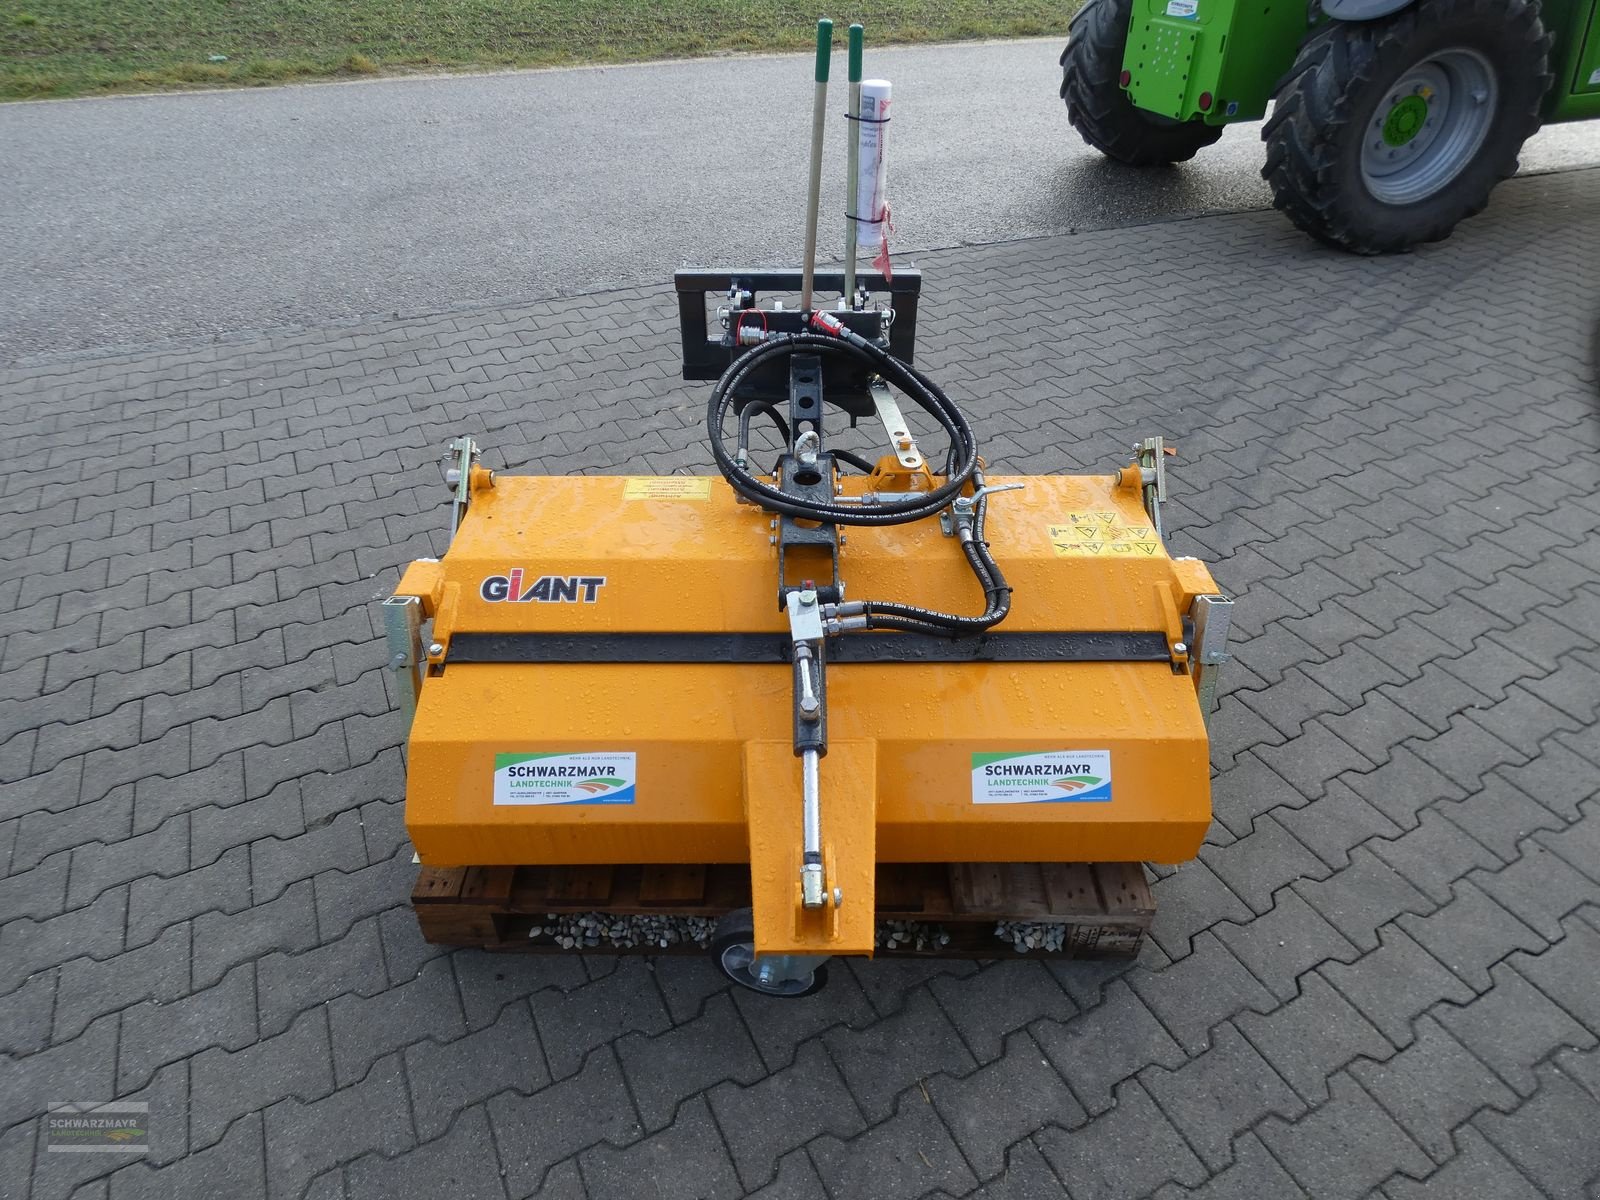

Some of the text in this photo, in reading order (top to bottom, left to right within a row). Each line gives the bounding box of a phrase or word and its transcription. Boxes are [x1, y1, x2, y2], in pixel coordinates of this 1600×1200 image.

[508, 766, 616, 777] SCHWARZMAYR
[985, 764, 1091, 776] SCHWARZMAYR
[509, 780, 573, 788] LANDTECHNIK
[987, 778, 1050, 787] LANDTECHNIK
